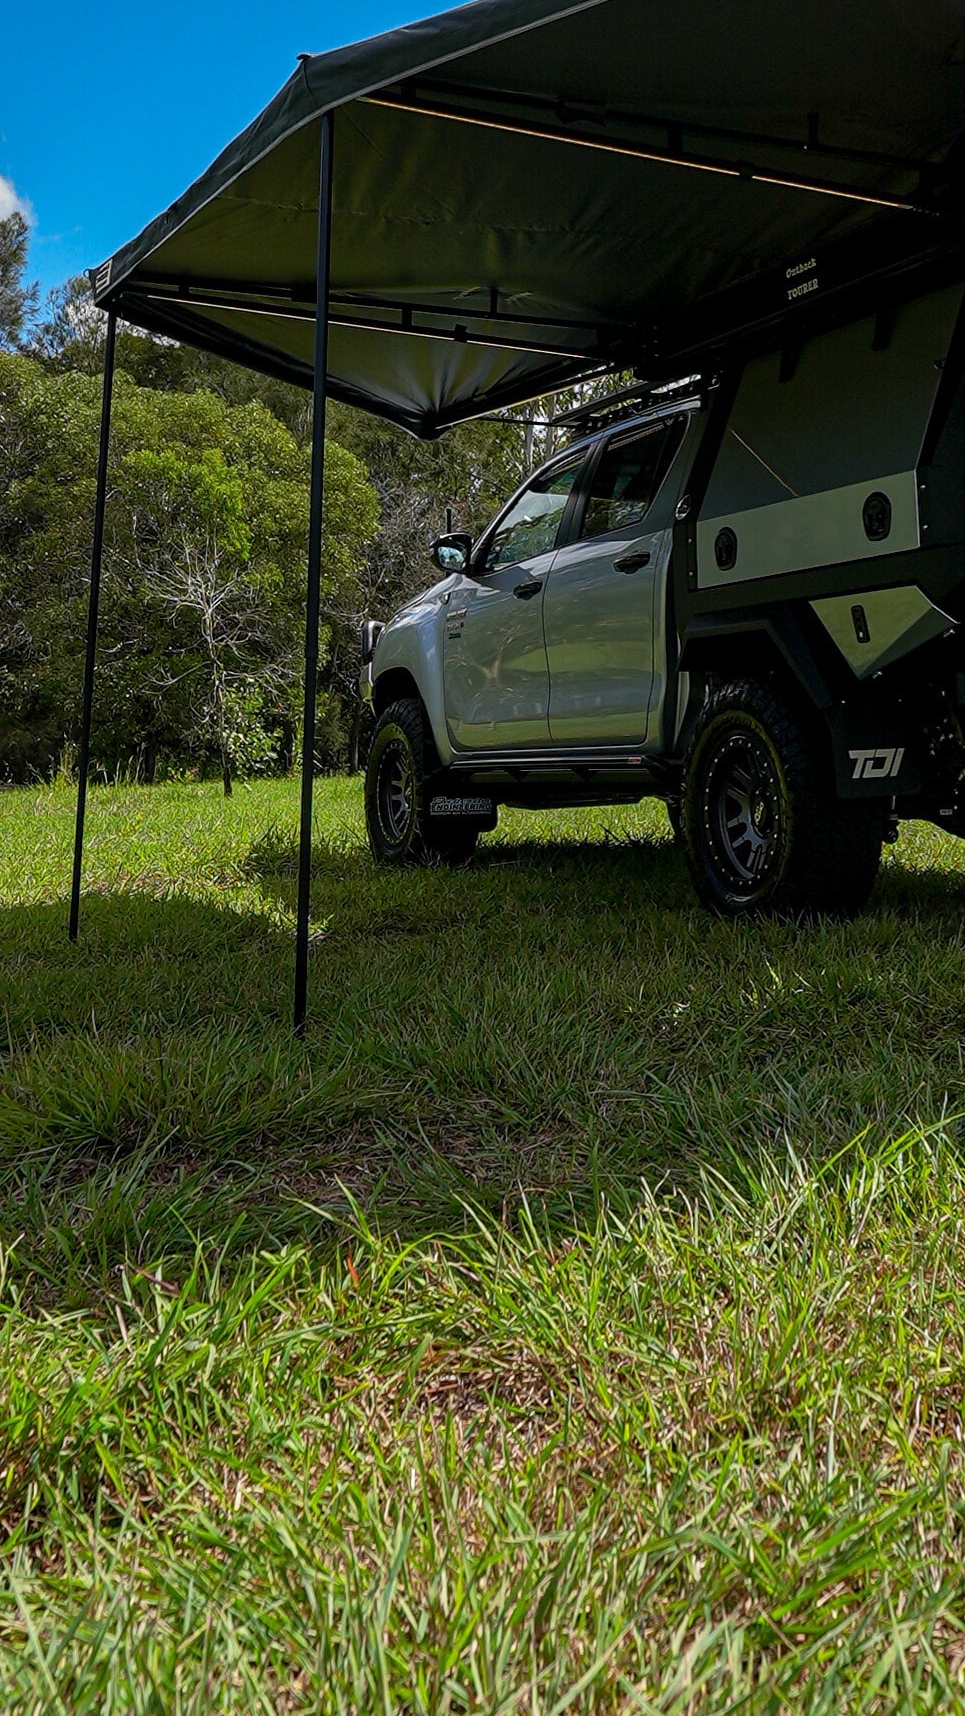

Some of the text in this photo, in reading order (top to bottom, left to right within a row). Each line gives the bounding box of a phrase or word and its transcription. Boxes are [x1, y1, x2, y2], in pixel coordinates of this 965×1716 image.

[785, 257, 817, 279] Outback
[786, 278, 819, 301] TOURER
[847, 747, 906, 780] TDI
